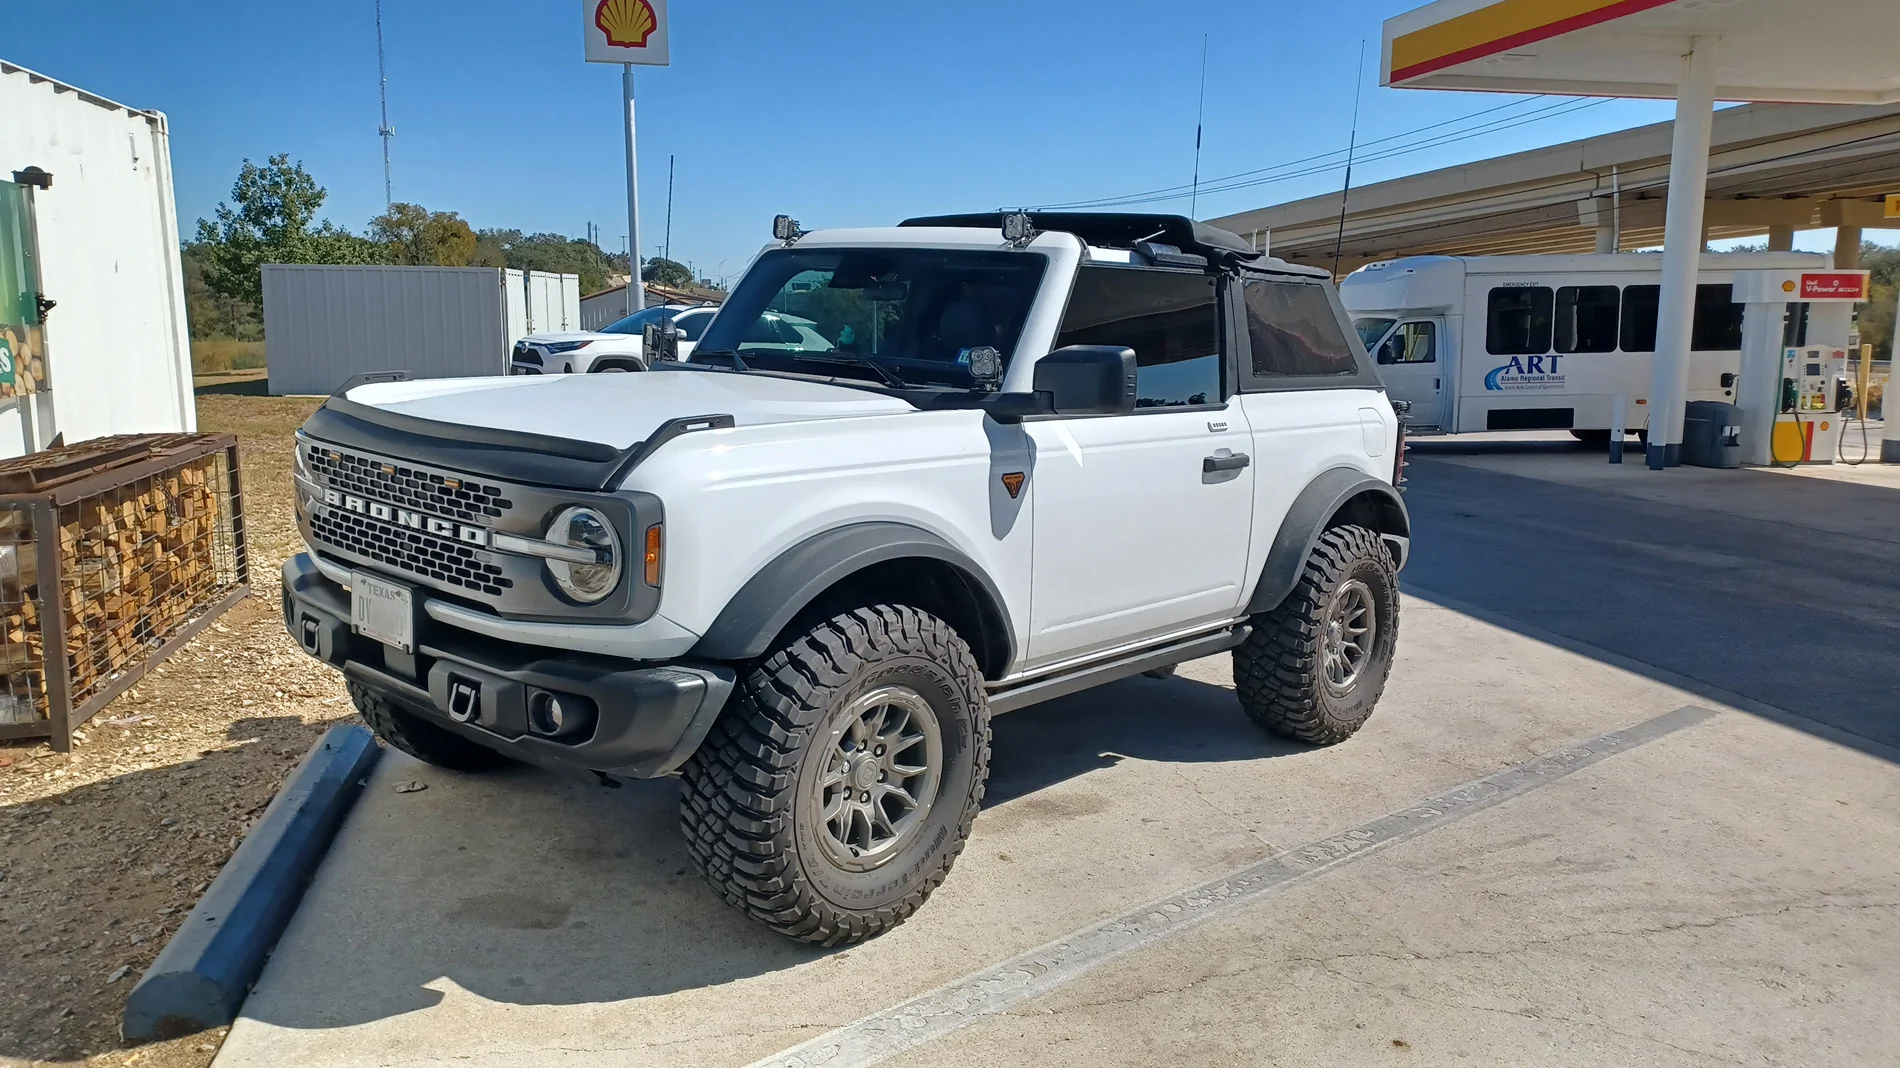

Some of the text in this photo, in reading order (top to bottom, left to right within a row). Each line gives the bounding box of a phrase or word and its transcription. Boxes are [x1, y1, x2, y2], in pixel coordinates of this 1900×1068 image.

[1504, 355, 1564, 375] ART
[1520, 375, 1545, 383] Regional
[324, 488, 489, 546] BRONCO
[367, 583, 396, 600] TEXAS
